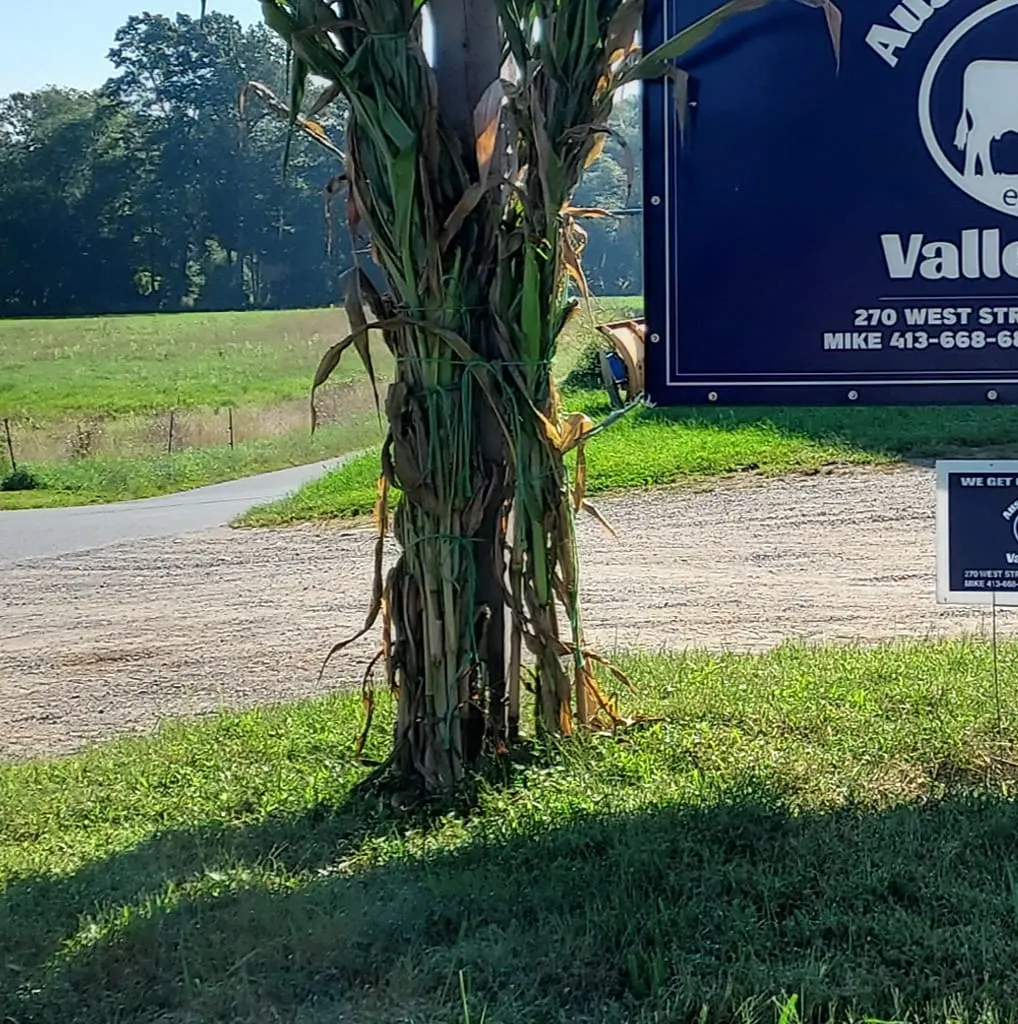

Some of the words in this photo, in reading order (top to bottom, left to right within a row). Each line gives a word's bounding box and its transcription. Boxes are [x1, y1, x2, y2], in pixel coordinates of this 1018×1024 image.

[854, 308, 897, 326] 270
[904, 307, 972, 325] WEST
[823, 332, 885, 350] MIKE
[960, 477, 984, 486] WE
[986, 477, 1013, 487] GET
[979, 570, 1003, 578] WEST
[964, 579, 985, 588] MIKE
